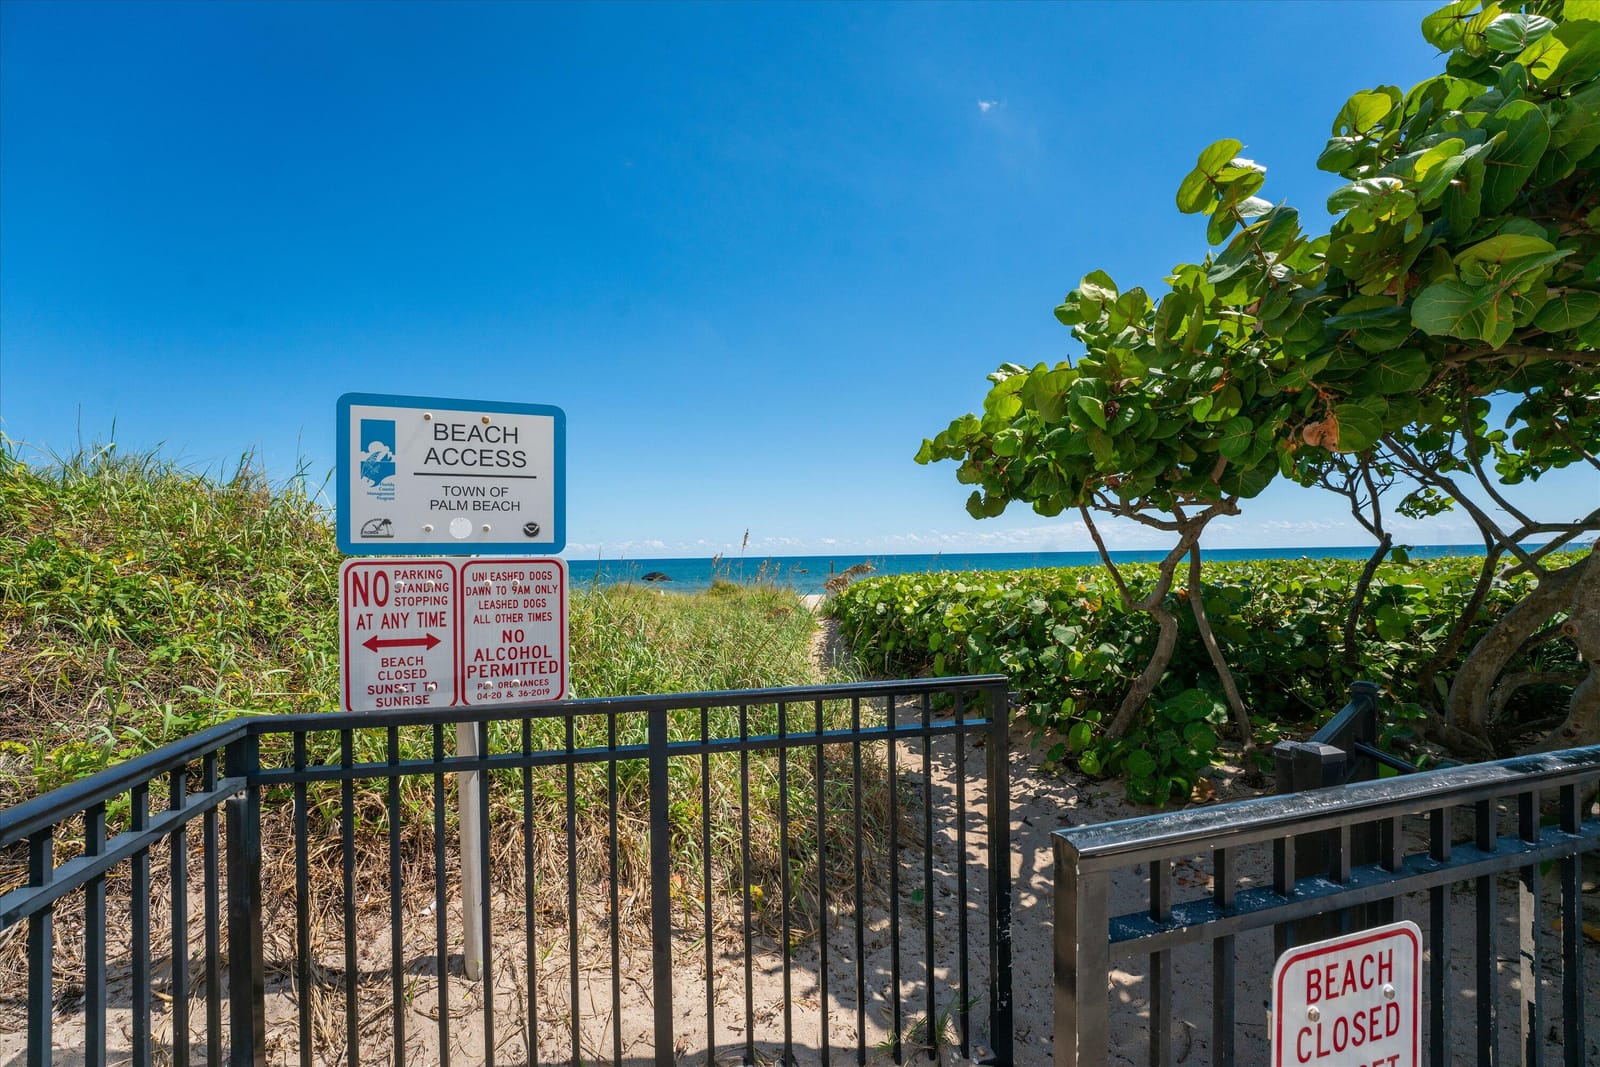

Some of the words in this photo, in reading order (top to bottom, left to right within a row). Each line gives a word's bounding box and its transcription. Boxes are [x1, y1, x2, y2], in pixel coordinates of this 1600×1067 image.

[434, 423, 518, 444] BEACH
[424, 447, 527, 468] ACCESS
[442, 485, 485, 497] TOWN
[490, 486, 509, 497] OF
[430, 499, 468, 511] PALM
[472, 500, 521, 512] BEACH
[394, 569, 443, 580] PARKING
[472, 571, 525, 582] UNLEASHED
[529, 571, 553, 581] DOGS
[352, 570, 389, 608] NO
[466, 586, 491, 596] DAWN
[496, 586, 507, 596] TO
[511, 584, 531, 595] 9AM
[535, 584, 558, 595] ONLY
[394, 595, 448, 607] STOPPING
[478, 599, 519, 610] LEASHED
[523, 598, 547, 608] DOGS
[356, 613, 373, 631] AT
[381, 612, 410, 630] ANY
[417, 611, 447, 628] TIME
[473, 614, 491, 625] ALL
[495, 613, 524, 624] OTHER
[528, 611, 553, 622] TIMES
[502, 628, 525, 643] NO
[474, 644, 552, 663] ALCOHOL
[381, 655, 424, 668] BEACH
[377, 668, 427, 681] CLOSED
[467, 660, 559, 679] PERMITTED
[367, 682, 416, 695] SUNSET
[476, 692, 502, 701] 04-20
[506, 690, 514, 699] &
[518, 688, 550, 698] 36-2019
[376, 694, 430, 708] SUNRISE
[1306, 948, 1393, 1005] BEACH
[1296, 1001, 1400, 1064] CLOSED
